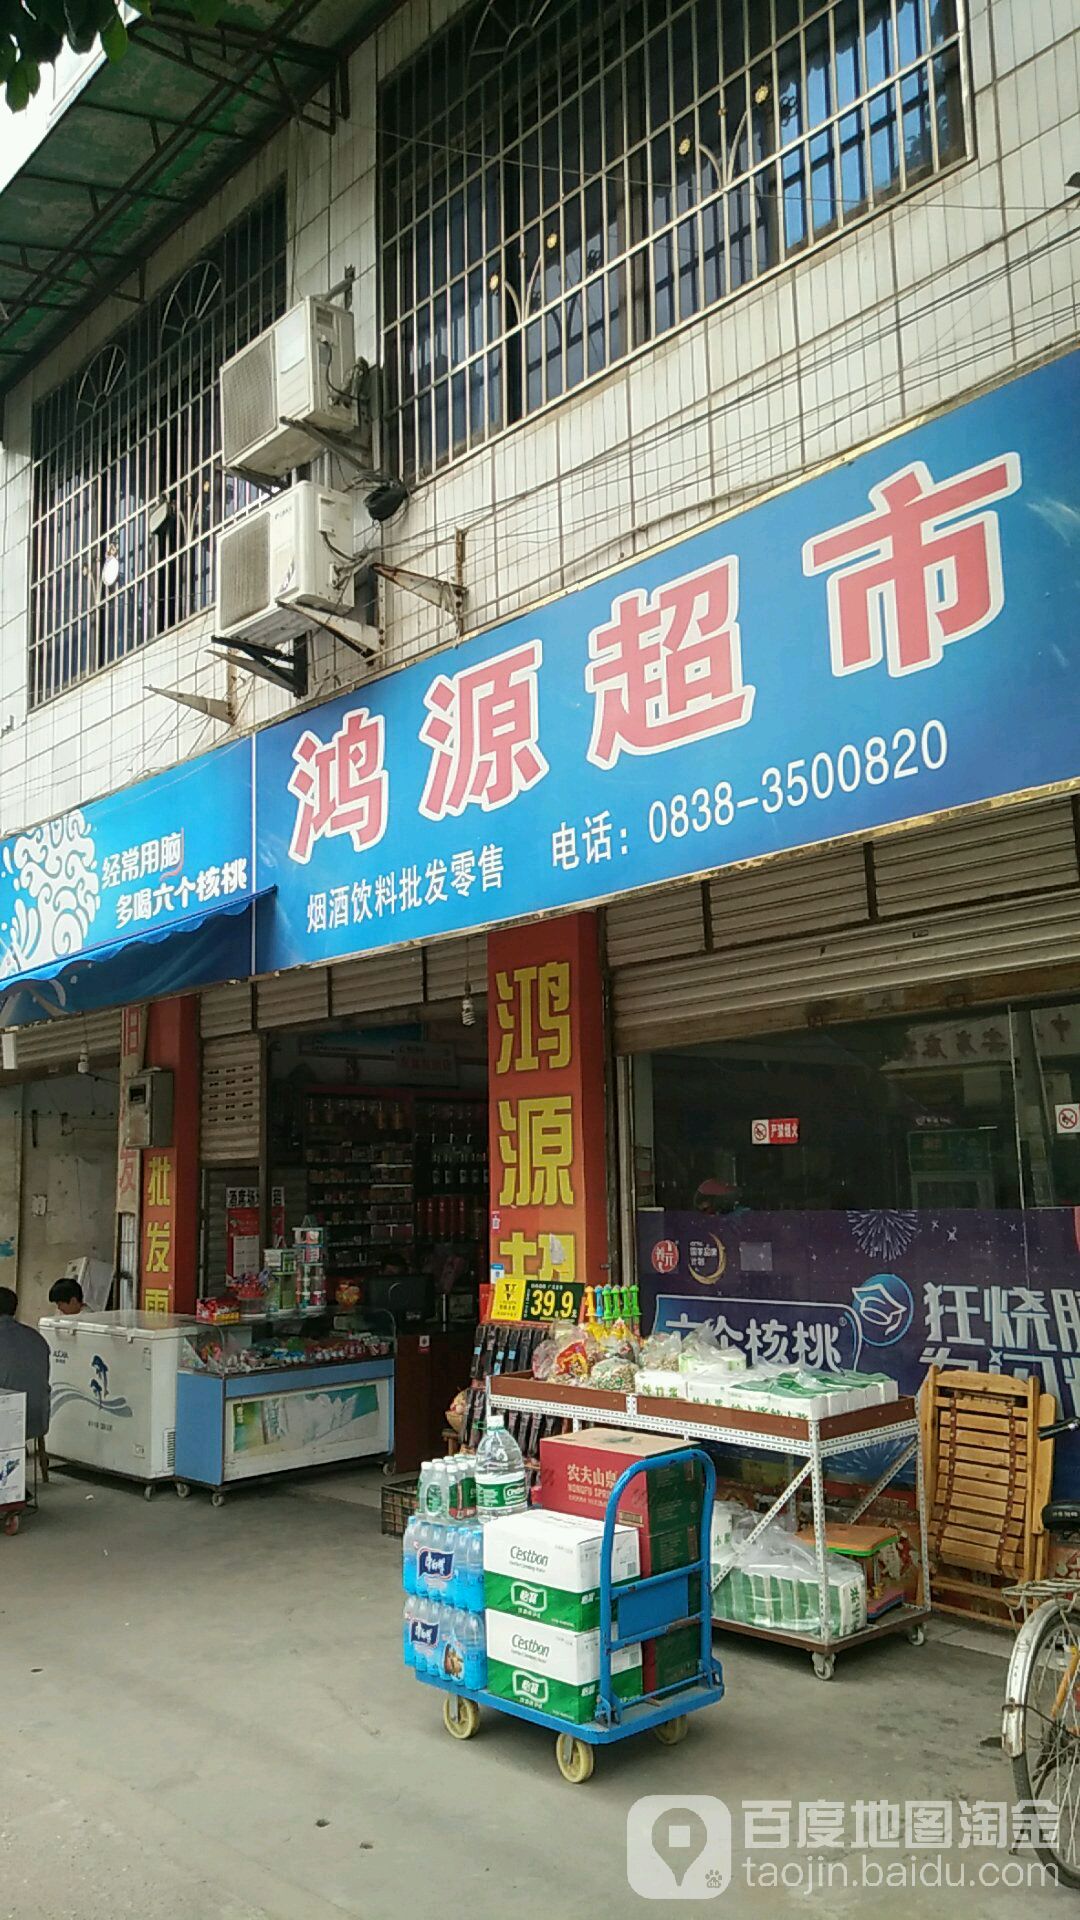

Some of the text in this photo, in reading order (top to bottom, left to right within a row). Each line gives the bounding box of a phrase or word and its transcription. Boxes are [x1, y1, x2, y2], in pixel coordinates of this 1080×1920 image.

[287, 451, 1023, 866] 鸿源超市
[102, 830, 184, 888] 经常用脑
[115, 857, 248, 930] 多喝六个核桃
[306, 844, 505, 934] 烟酒饮料批发零售
